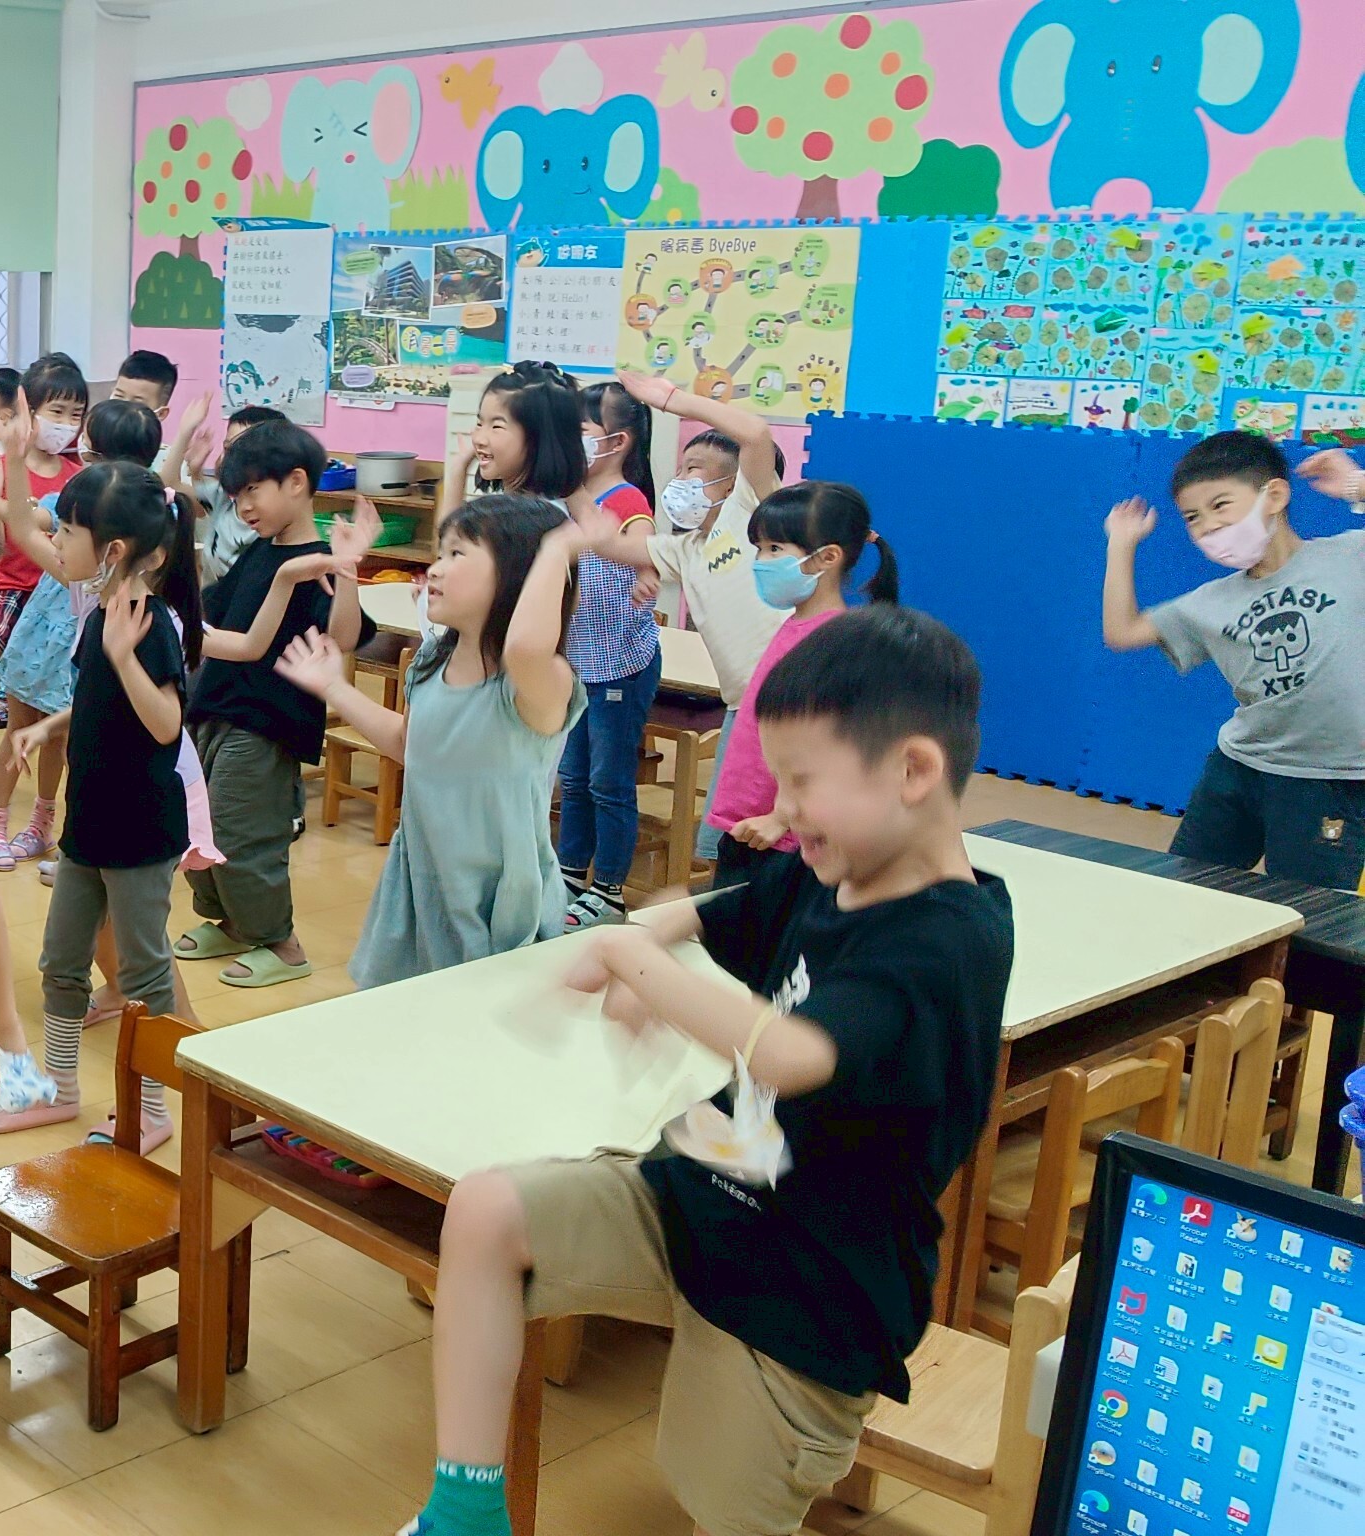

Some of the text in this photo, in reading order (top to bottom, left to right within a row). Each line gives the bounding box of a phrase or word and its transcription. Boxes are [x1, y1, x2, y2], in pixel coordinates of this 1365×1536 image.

[709, 238, 757, 254] ByeBye
[1222, 586, 1337, 641] ECSTASY
[1229, 1508, 1247, 1520] PDF
